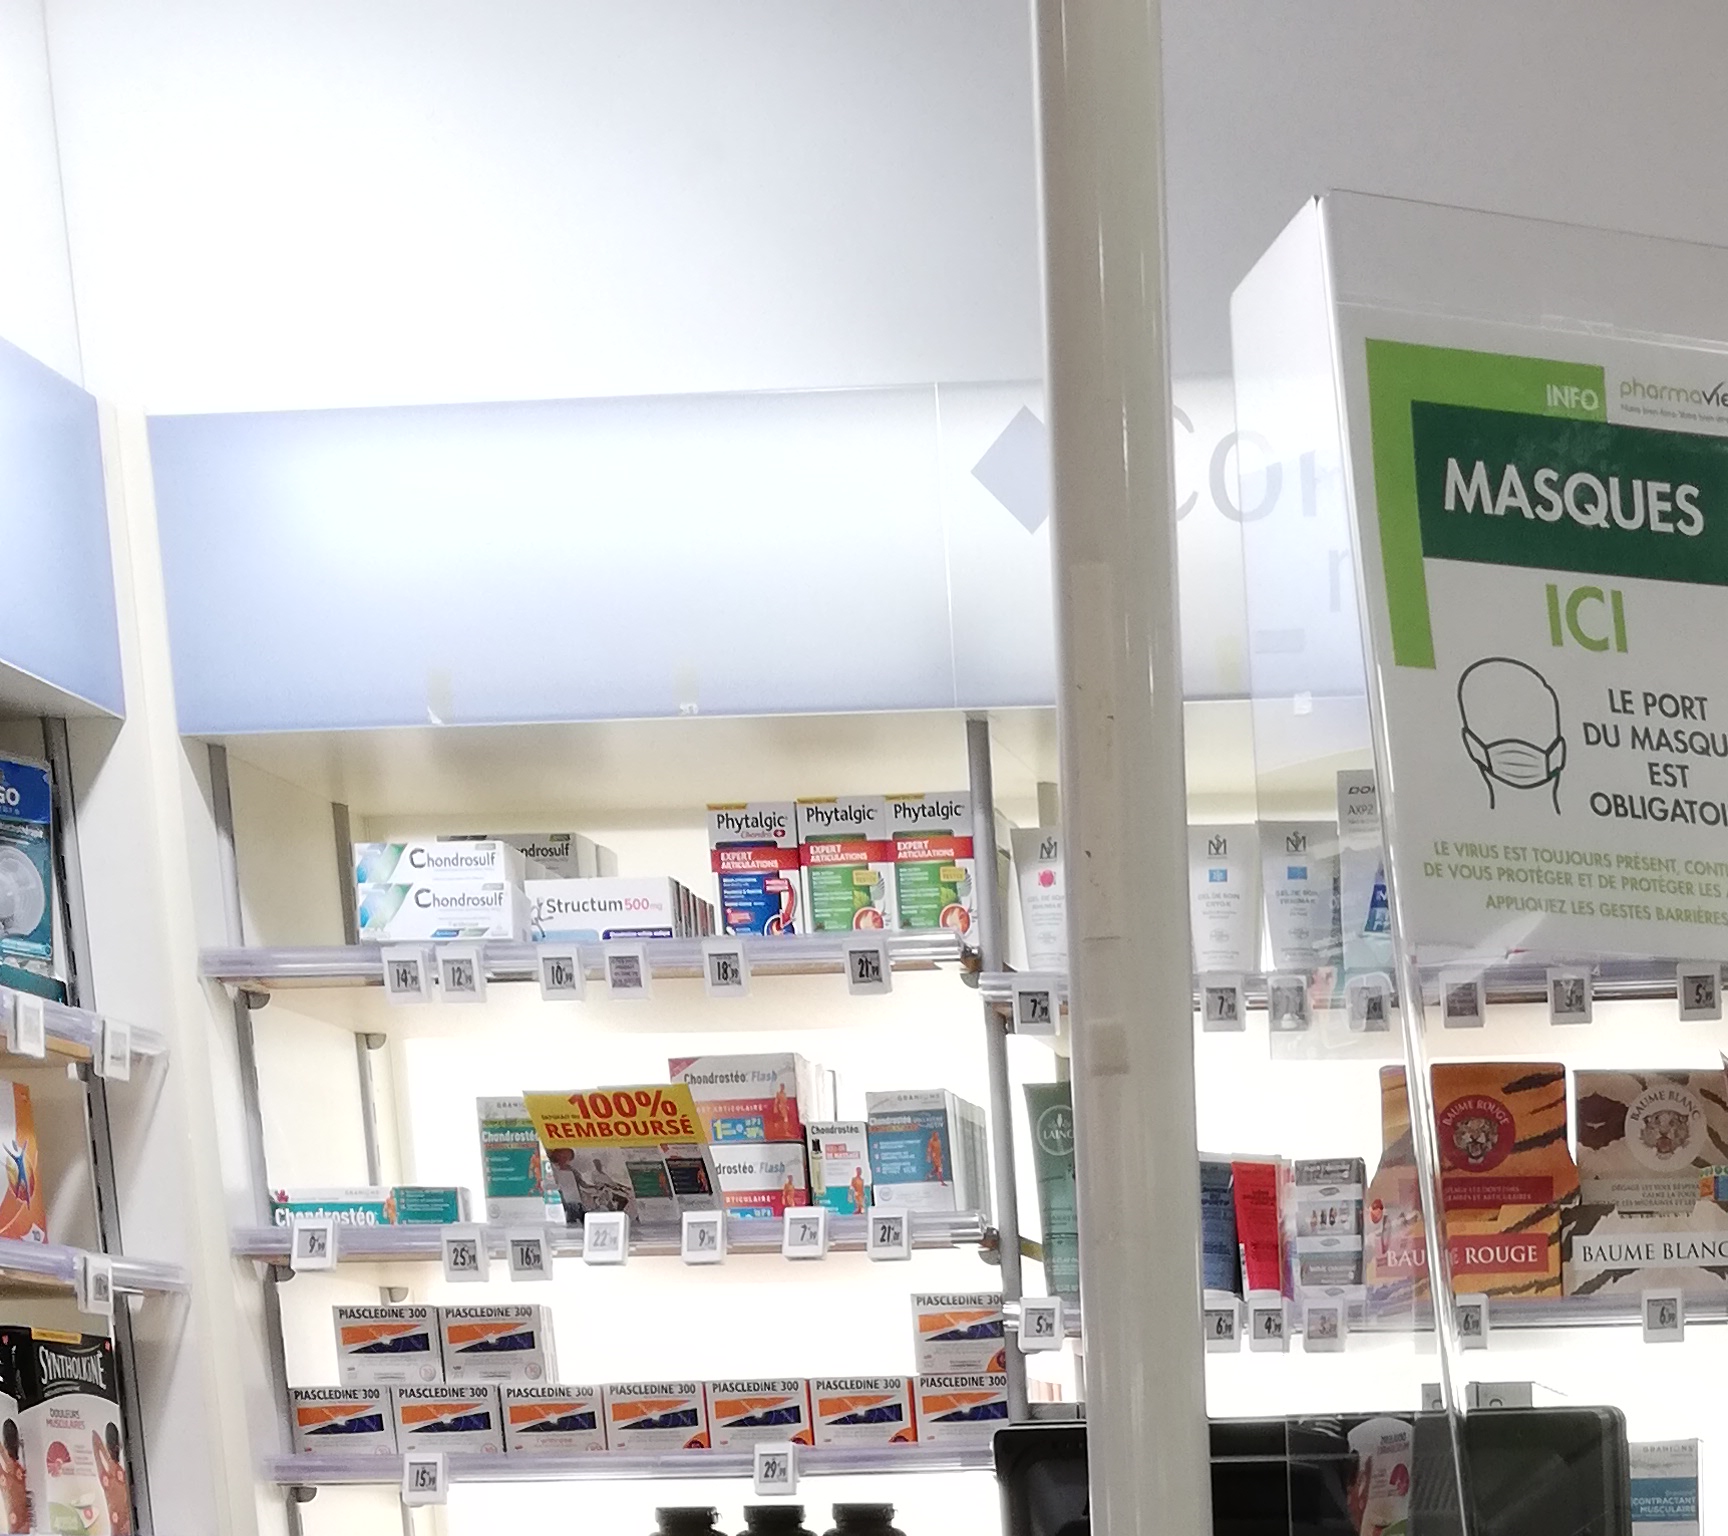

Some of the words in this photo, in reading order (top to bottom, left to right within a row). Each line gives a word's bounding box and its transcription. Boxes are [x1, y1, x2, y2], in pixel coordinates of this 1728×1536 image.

[1546, 384, 1599, 411] INFO
[1444, 457, 1704, 536] MASQUES
[1545, 583, 1628, 653] ICI
[1608, 688, 1635, 715] LE
[1643, 692, 1708, 721] PORT
[1582, 722, 1621, 748] DU
[1648, 762, 1690, 789] EST
[716, 812, 786, 832] Phytalgic
[806, 806, 875, 826] Phytalgic
[409, 848, 496, 869] Chondrosulf
[1434, 841, 1450, 857] LE
[1453, 842, 1499, 860] VIRUS
[1503, 845, 1528, 862] EST
[1531, 847, 1611, 869] TOUJOURS
[1423, 861, 1444, 878] DE
[1447, 863, 1493, 881] VOUS
[1498, 864, 1573, 888] PROTÉGER
[1577, 872, 1594, 888] ET
[1598, 873, 1617, 890] DE
[1621, 874, 1694, 897] PROTÉGER
[1698, 880, 1722, 898] LES
[547, 898, 623, 914] Structum
[1485, 894, 1566, 916] APPLIQUEZ
[1571, 899, 1596, 916] LES
[1599, 904, 1652, 921] GESTES
[568, 1090, 678, 1121] 100%
[545, 1115, 695, 1140] REMBOURSÉ
[1465, 1245, 1538, 1265] ROUGE
[1582, 1243, 1655, 1262] BAUME
[338, 1307, 405, 1320] PIASCLEDINE
[408, 1306, 426, 1319] 300
